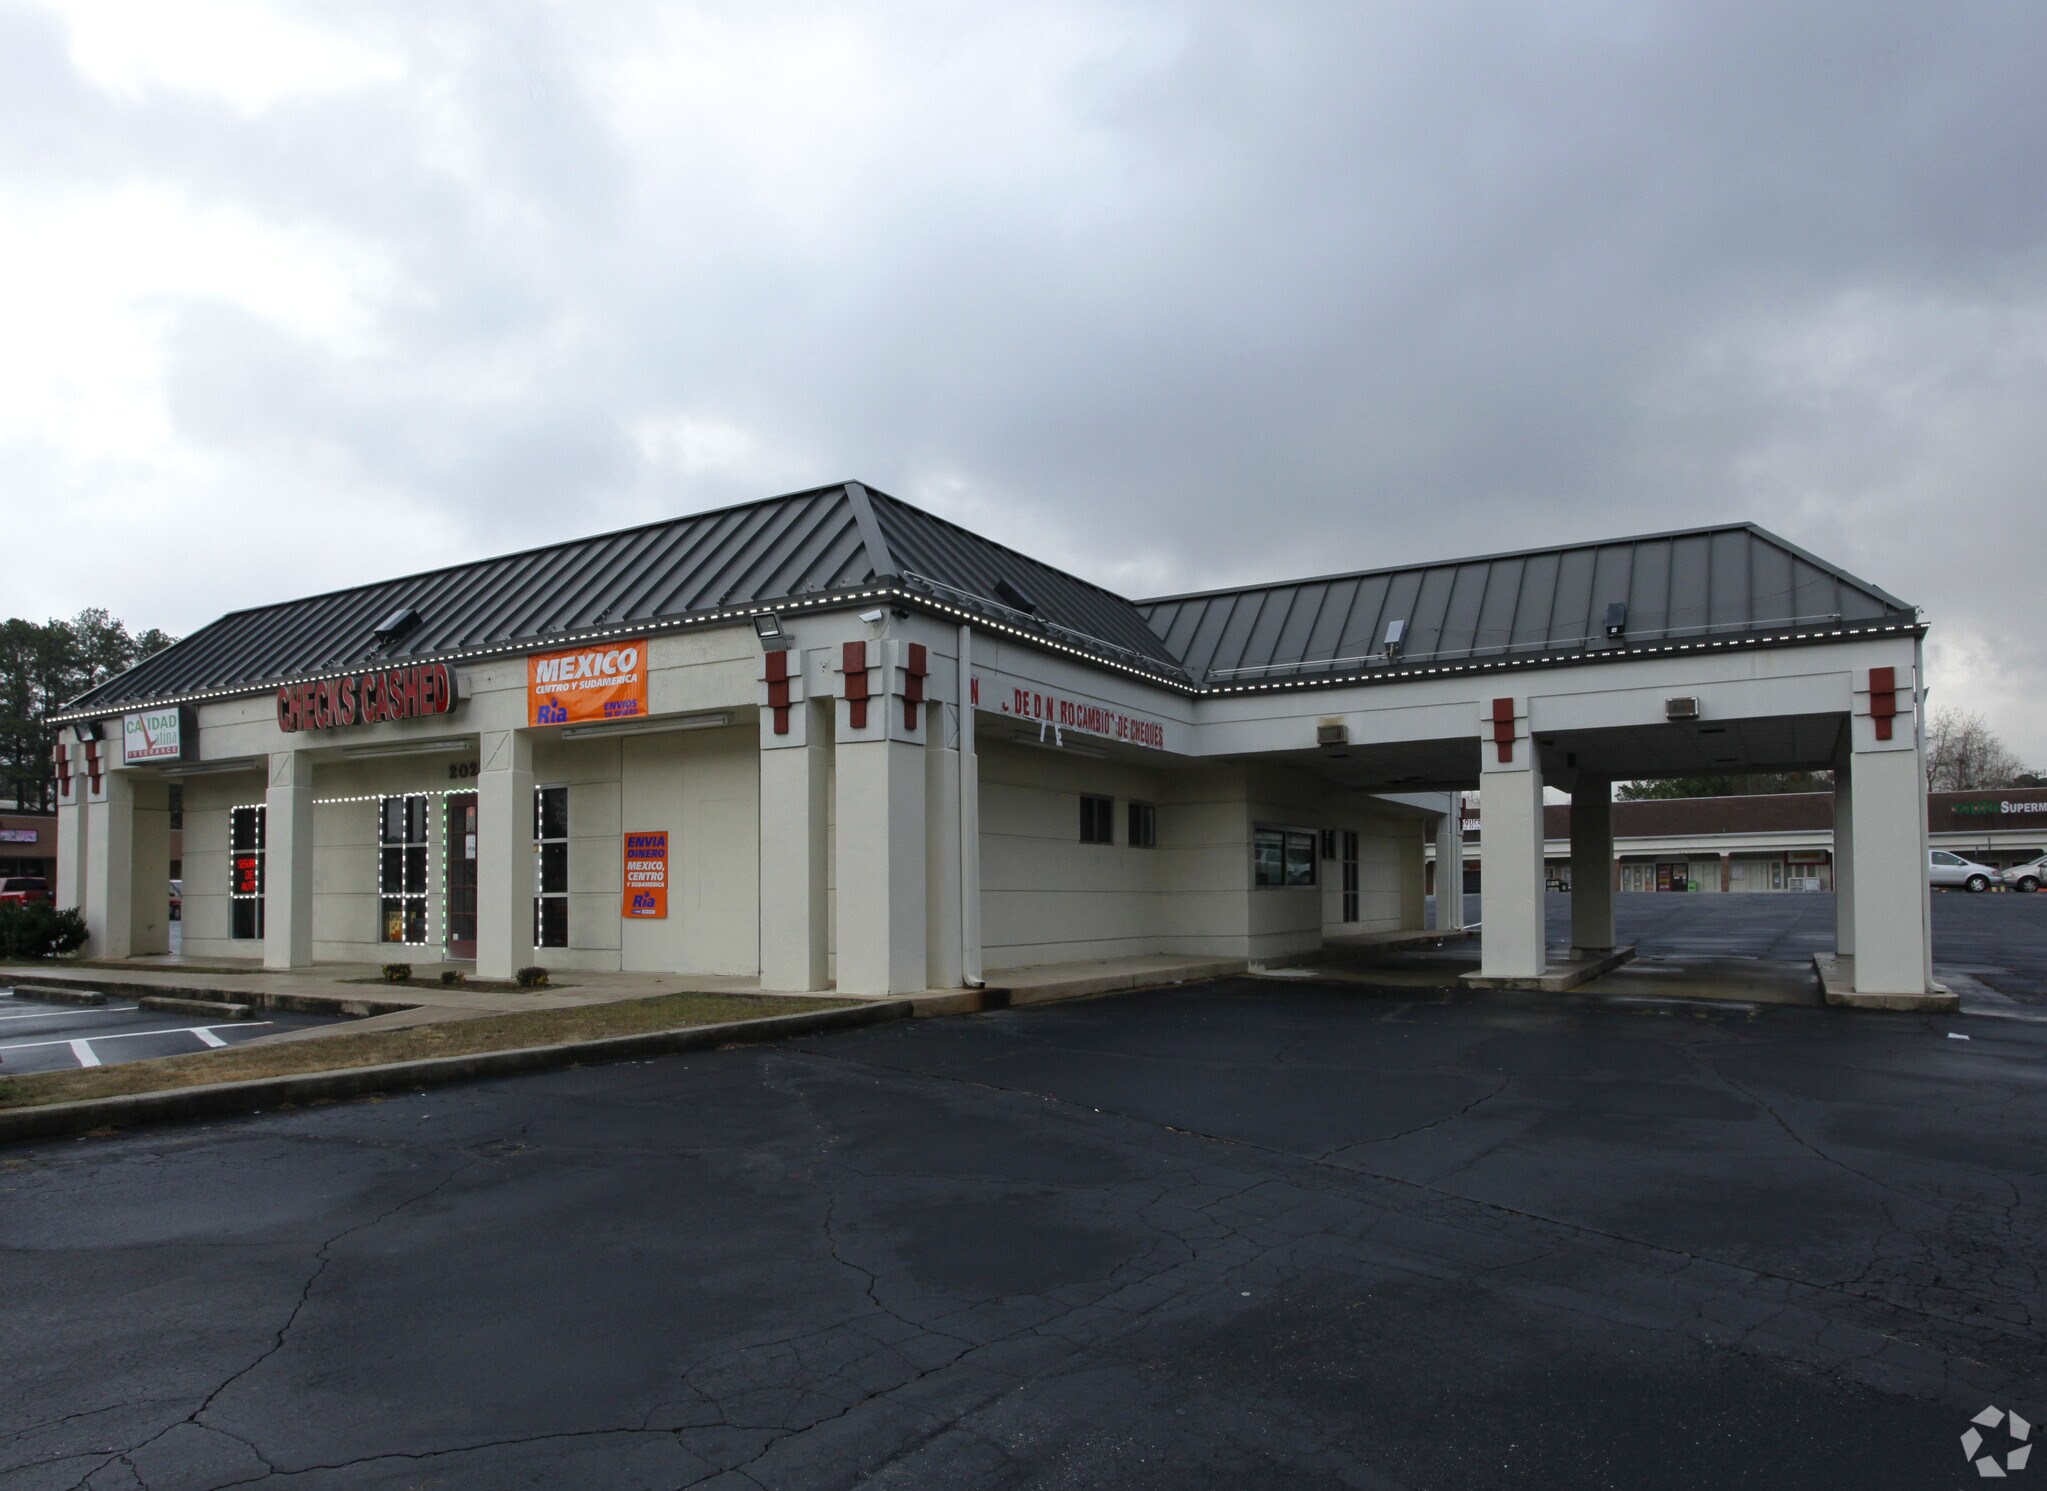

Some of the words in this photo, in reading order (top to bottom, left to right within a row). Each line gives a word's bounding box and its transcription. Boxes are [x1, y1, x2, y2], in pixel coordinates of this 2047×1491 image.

[536, 647, 638, 683] MEXICO
[536, 682, 569, 694] CENTRO
[571, 681, 578, 690] Y
[579, 674, 638, 689] SUDAMERICA
[277, 676, 356, 732] CHECKS
[361, 663, 450, 724] CASHED
[537, 697, 568, 724] Ria
[604, 699, 637, 710] ENVIOS
[614, 708, 638, 716] DINERO
[1014, 689, 1030, 716] DE
[1117, 715, 1128, 737] DE
[1130, 718, 1164, 747] CHEQUES
[128, 746, 177, 758] INSURANCE
[627, 836, 665, 847] ENVIA
[627, 849, 665, 858] DINERO
[627, 861, 665, 871] MEXICO,
[627, 872, 664, 881] CENTRO
[633, 891, 655, 907] Ria
